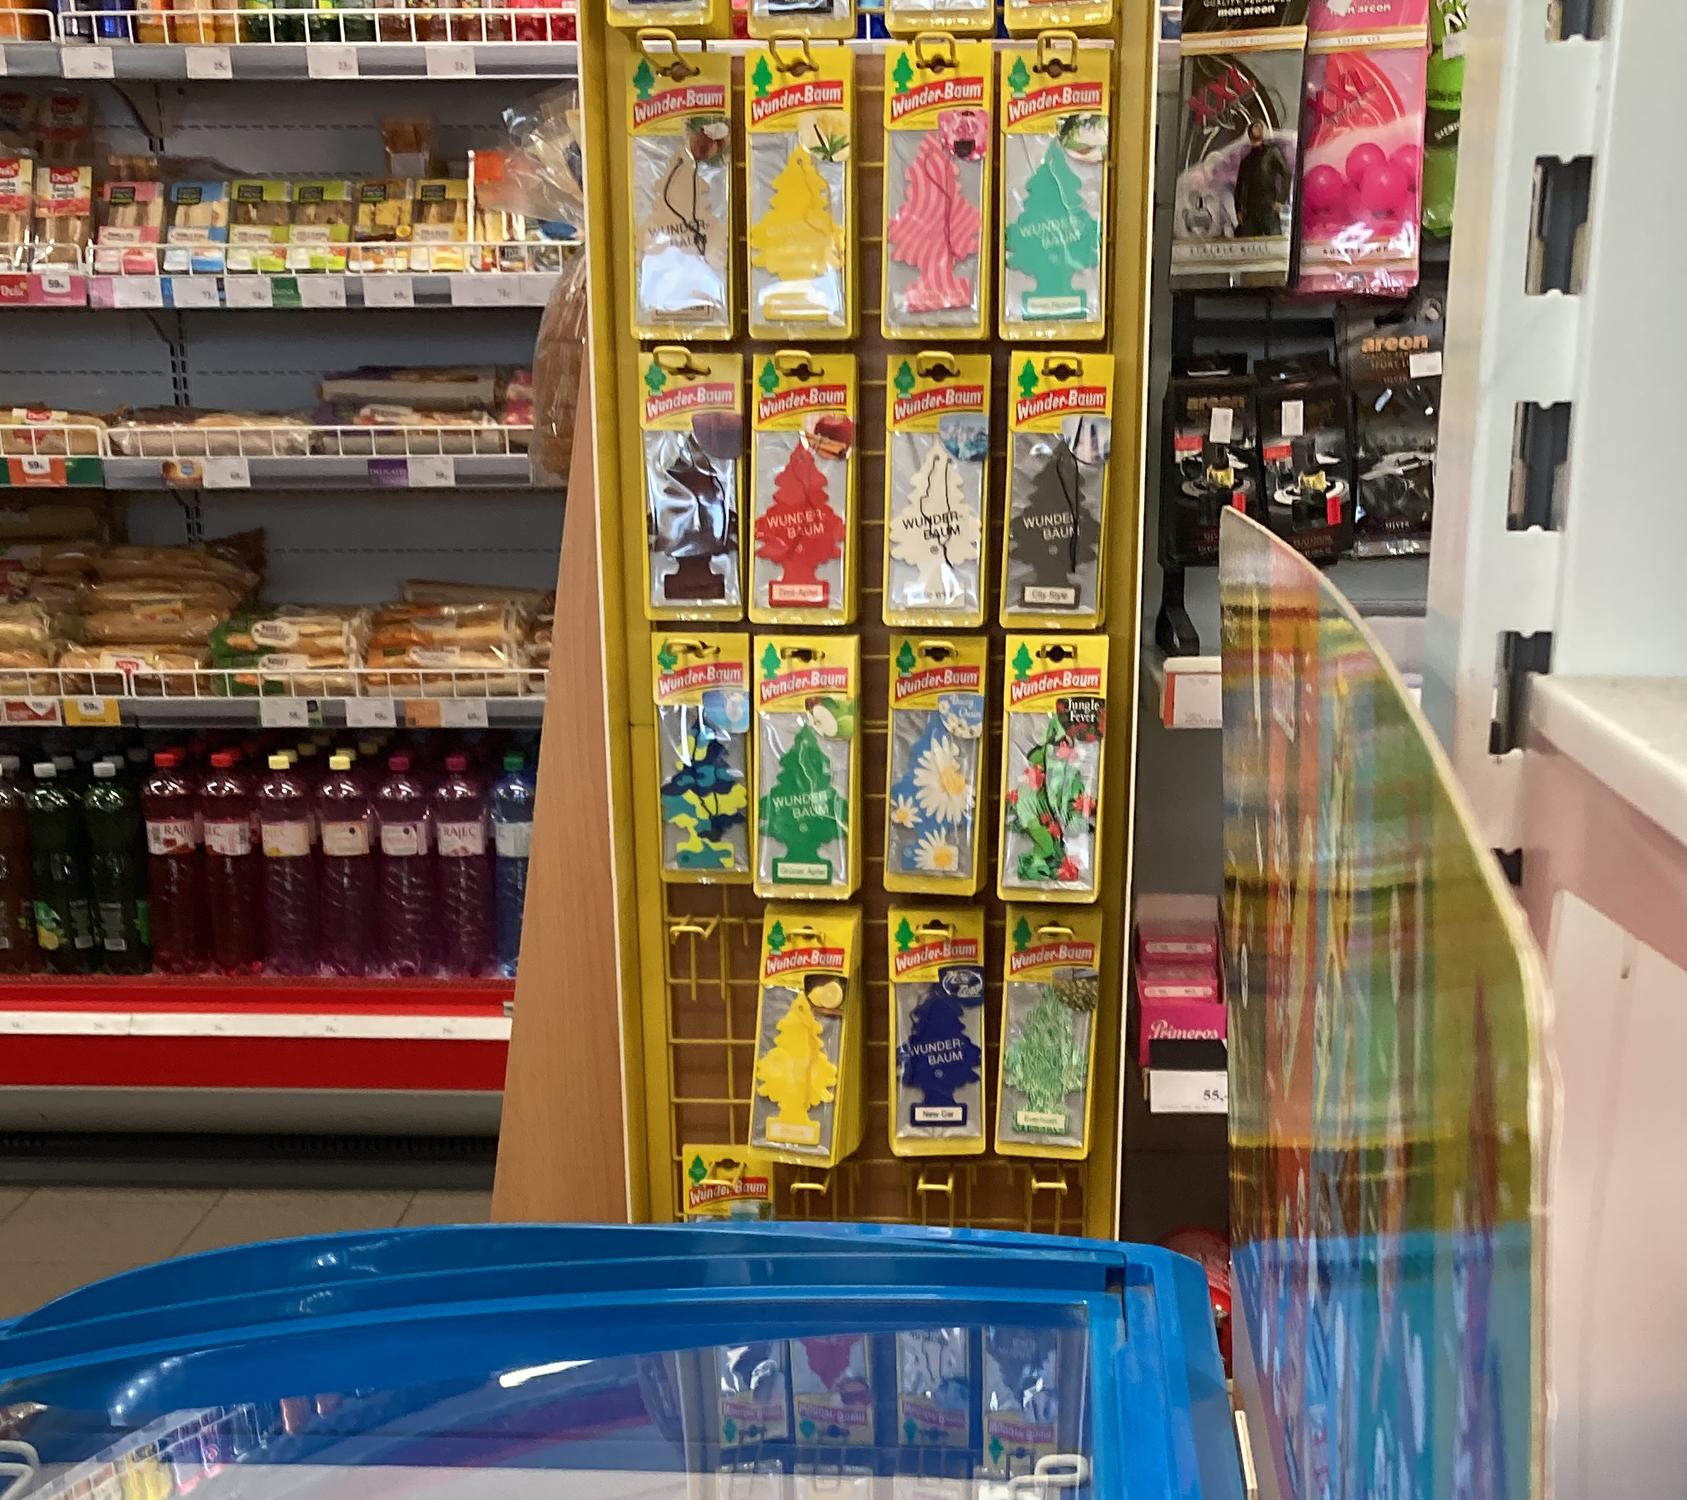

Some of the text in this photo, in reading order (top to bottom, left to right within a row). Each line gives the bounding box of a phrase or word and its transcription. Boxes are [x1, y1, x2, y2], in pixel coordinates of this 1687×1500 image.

[634, 89, 725, 123] Wunder-Baum
[752, 86, 843, 121] Wunder-Baum
[892, 81, 983, 118] Wunder-Baum
[1008, 87, 1102, 123] Wunder-Baum
[1361, 335, 1429, 353] areon
[759, 388, 846, 420] Wunder-Baum
[894, 389, 983, 420] Wunder-Baum
[1017, 389, 1107, 421] Wunder-Baum
[659, 665, 743, 695] Wunder-Baum
[761, 671, 847, 701] Wunder-Baum
[896, 668, 979, 698] Wunder-Baum
[1011, 671, 1101, 701] Wunder-Baum
[1065, 698, 1101, 713] Jungle
[1069, 711, 1096, 723] Fever
[766, 949, 843, 975] Wunder-Baum
[896, 941, 978, 970] Wunder-Baum
[1010, 942, 1093, 971] Wunder-Baum
[1148, 1019, 1219, 1040] Primeros
[907, 1038, 966, 1056] WUNDER-
[927, 1051, 964, 1066] BAUM
